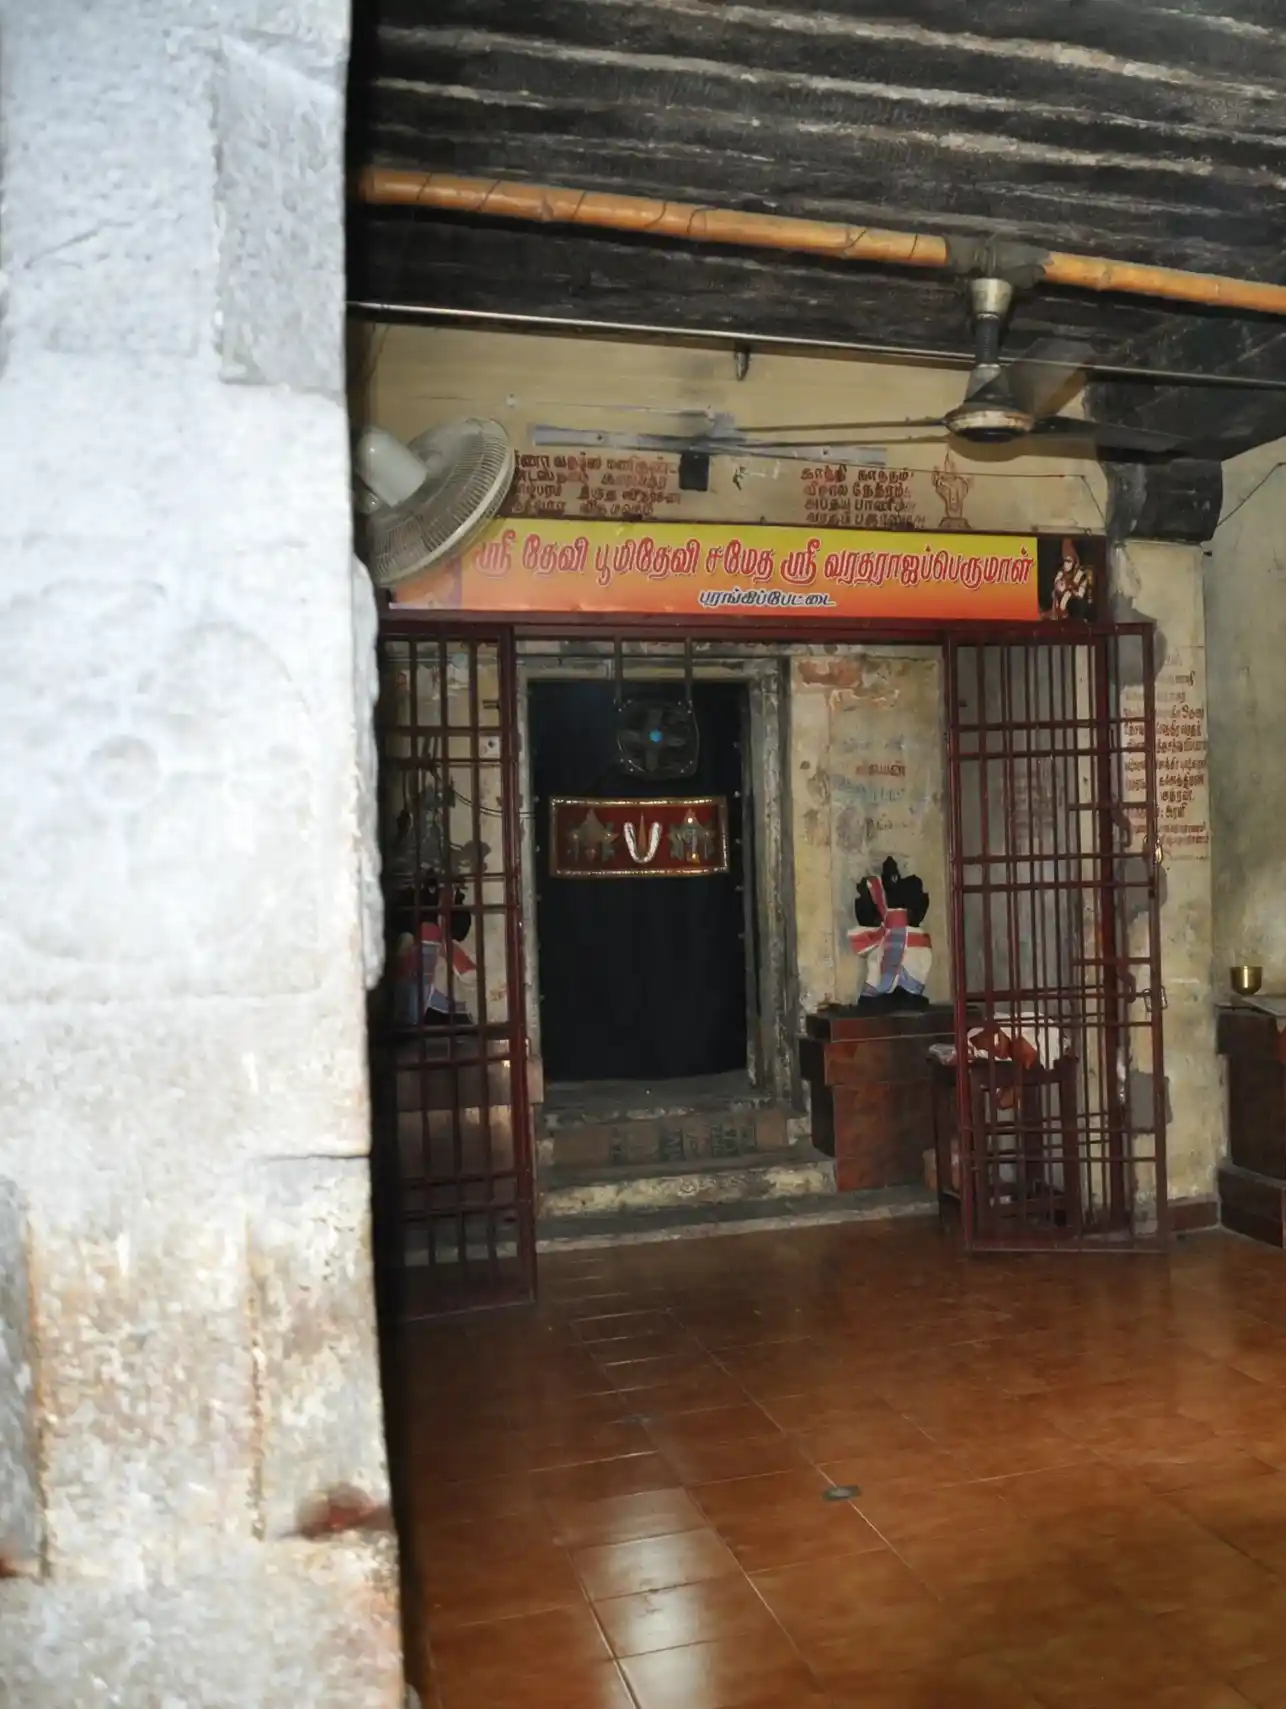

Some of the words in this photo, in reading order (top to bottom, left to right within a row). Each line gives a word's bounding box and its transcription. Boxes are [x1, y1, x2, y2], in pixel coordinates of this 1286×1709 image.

[475, 529, 517, 579] ஸ்ரீ
[523, 533, 589, 577] தேவி
[595, 537, 701, 586] பூமிதேவி
[706, 539, 774, 582] சமேத
[780, 538, 820, 584] ஸ்ரீ
[825, 545, 1033, 590] வரதராஜப்பெருமாள்
[699, 587, 836, 606] பரங்கிப்பேட்டை
